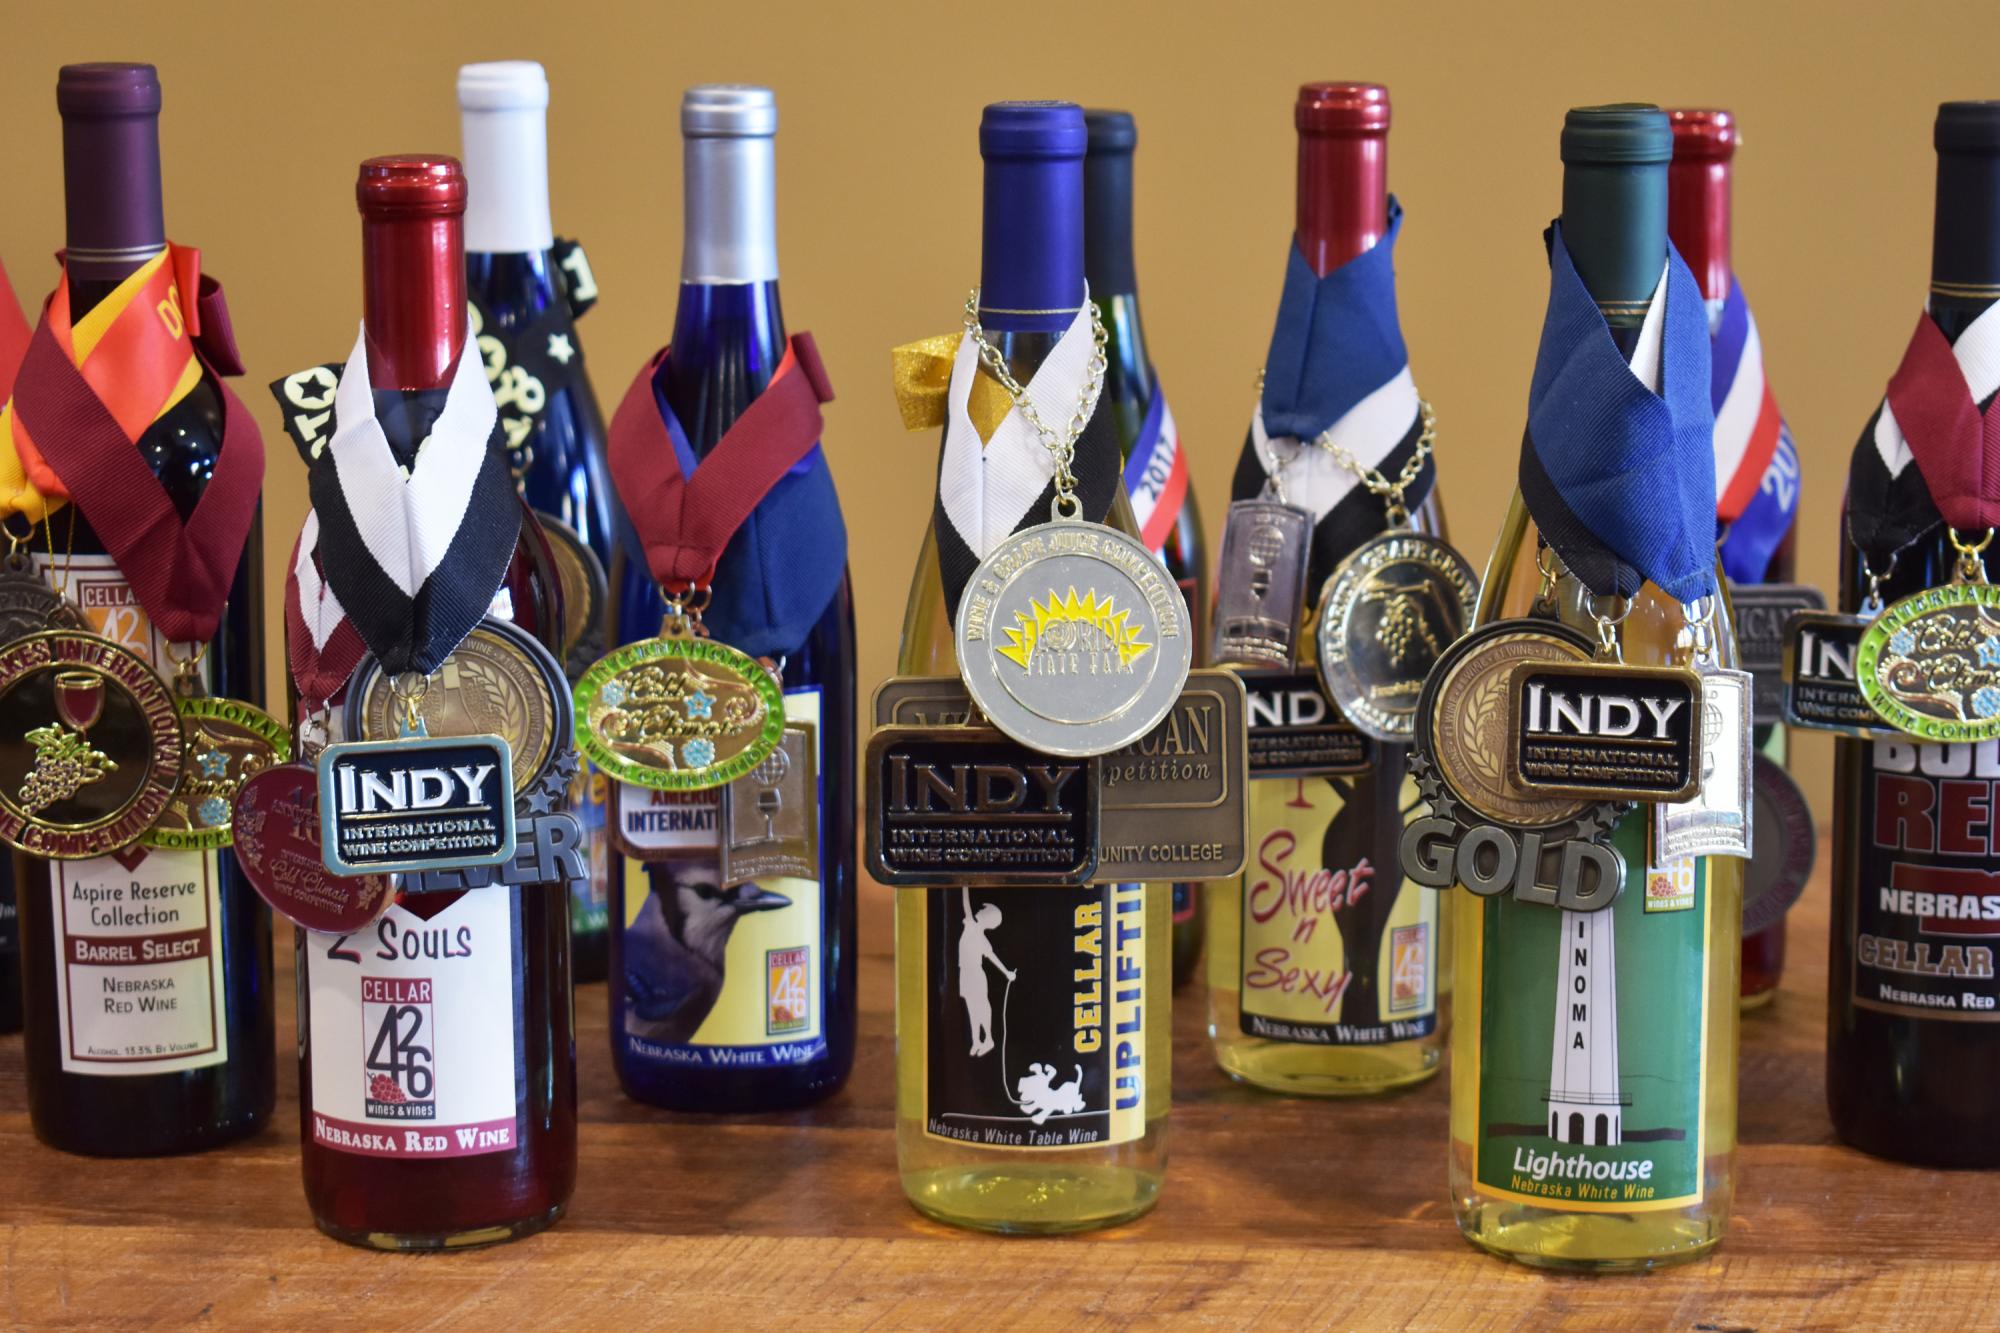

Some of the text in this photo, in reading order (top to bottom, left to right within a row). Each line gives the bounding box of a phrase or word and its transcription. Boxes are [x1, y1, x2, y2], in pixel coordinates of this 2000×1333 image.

[85, 587, 137, 606] CELLA
[967, 595, 992, 641] WINE
[993, 537, 1047, 580] GRAPE
[1022, 617, 1133, 656] FLORIDA
[1089, 651, 1134, 675] FAIR
[1527, 683, 1685, 739] INDY
[1527, 745, 1679, 767] INTERNATIONAL
[888, 754, 1081, 814] INDY
[1104, 760, 1211, 788] petition
[1526, 761, 1679, 784] WINE COMPETITION
[338, 763, 497, 814] INDY
[343, 818, 496, 840] INTERNATIONAL
[890, 828, 1075, 845] INTERNATIONAL
[343, 835, 497, 857] WINE COMPETITION
[889, 847, 1075, 863] WINE COMPETITION
[1149, 843, 1223, 862] COLLEGE
[1249, 829, 1376, 924] Sweet
[1401, 816, 1626, 911] GOLD
[73, 881, 197, 905] Aspire Reserve
[91, 906, 180, 927] Collection
[1292, 917, 1318, 944] n
[1857, 933, 1995, 979] CELLAR
[363, 980, 432, 1002] CELLAR
[1074, 901, 1102, 1054] CELLAR
[1245, 947, 1353, 1014] Sexy
[1572, 921, 1588, 1050] INOMA
[367, 1103, 396, 1117] wines
[405, 1103, 434, 1117] vines
[928, 1117, 1099, 1145] Nebraska White Table Wine
[1513, 1147, 1654, 1181] Lighthouse
[1511, 1174, 1656, 1200] Nebraska White Wine
